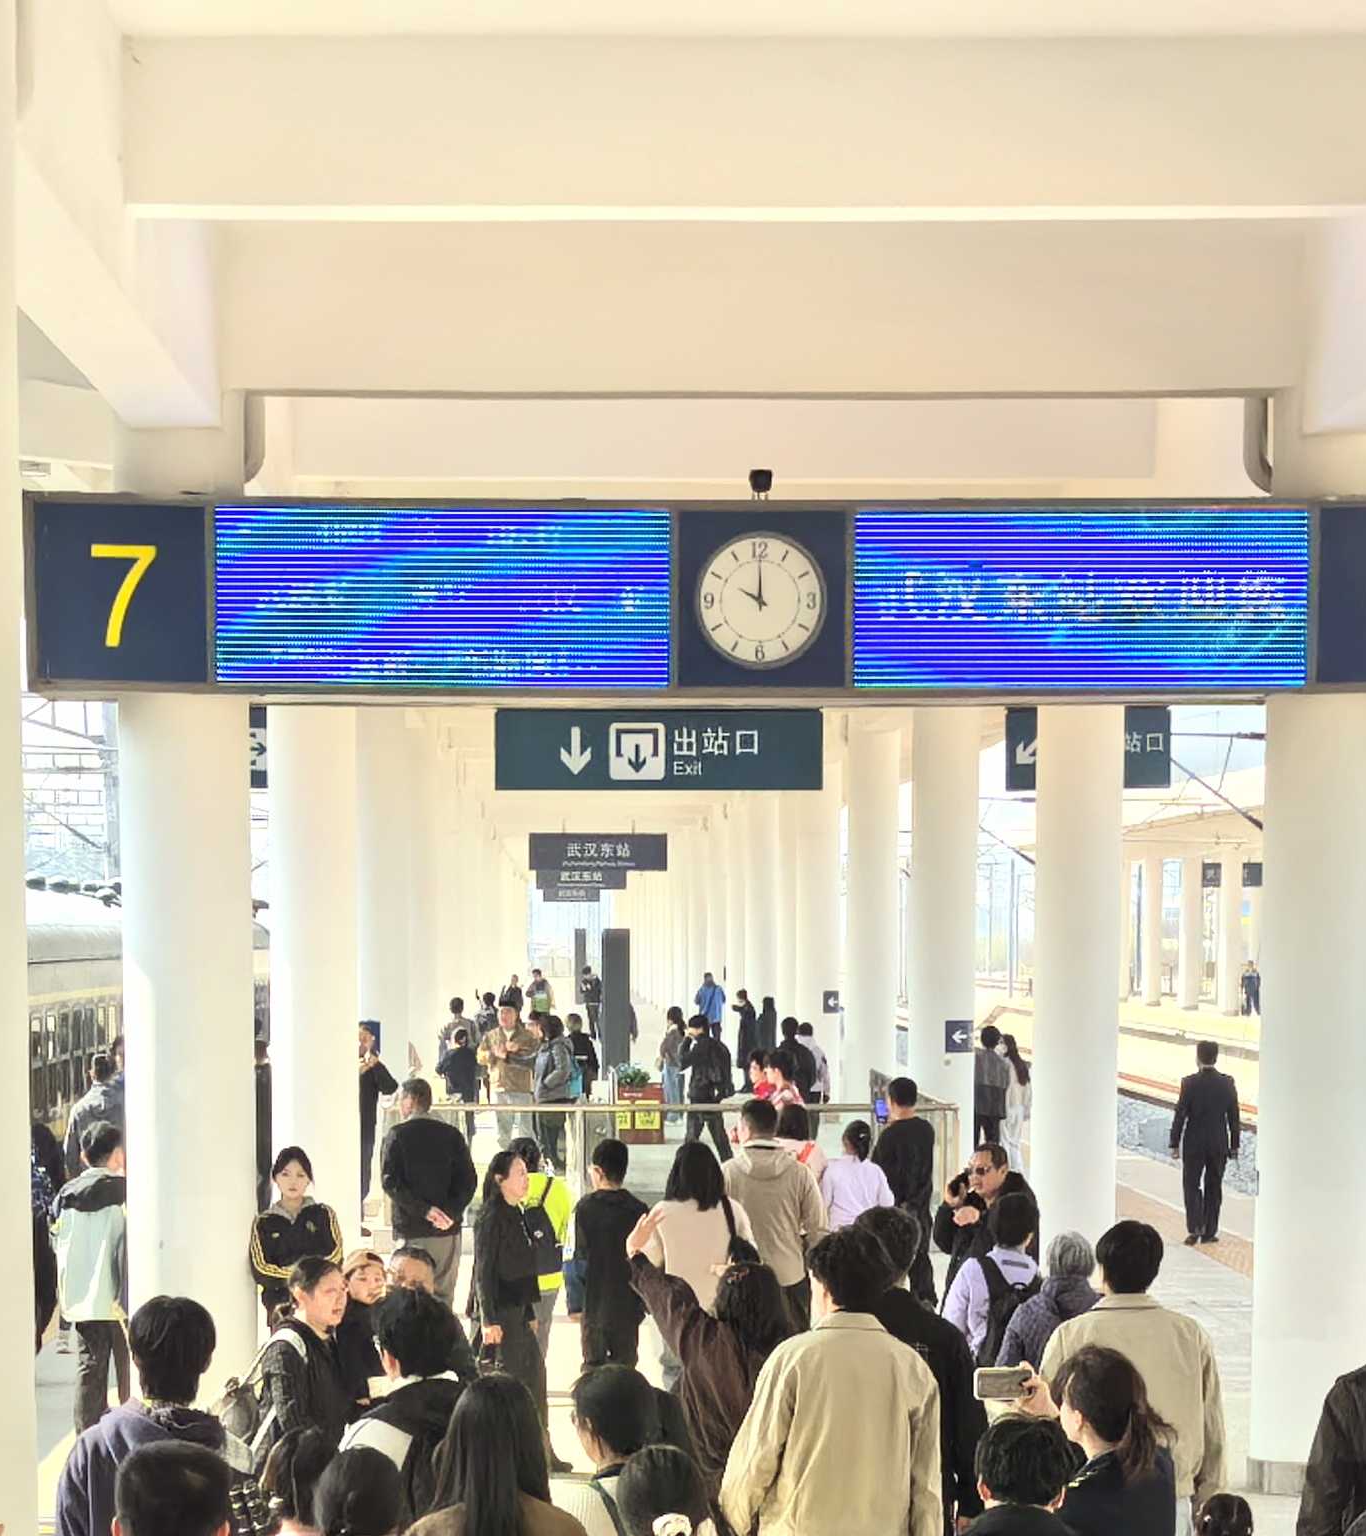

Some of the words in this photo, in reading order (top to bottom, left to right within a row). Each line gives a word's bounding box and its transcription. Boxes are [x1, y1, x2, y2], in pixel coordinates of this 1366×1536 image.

[751, 541, 768, 559] 12
[91, 544, 157, 647] 7
[704, 592, 715, 610] 9
[806, 592, 817, 610] 3
[755, 644, 765, 661] 6
[674, 726, 759, 756] 出站口
[1125, 731, 1164, 753] 站口
[673, 760, 702, 776] Exit
[566, 842, 631, 858] 武汉东站
